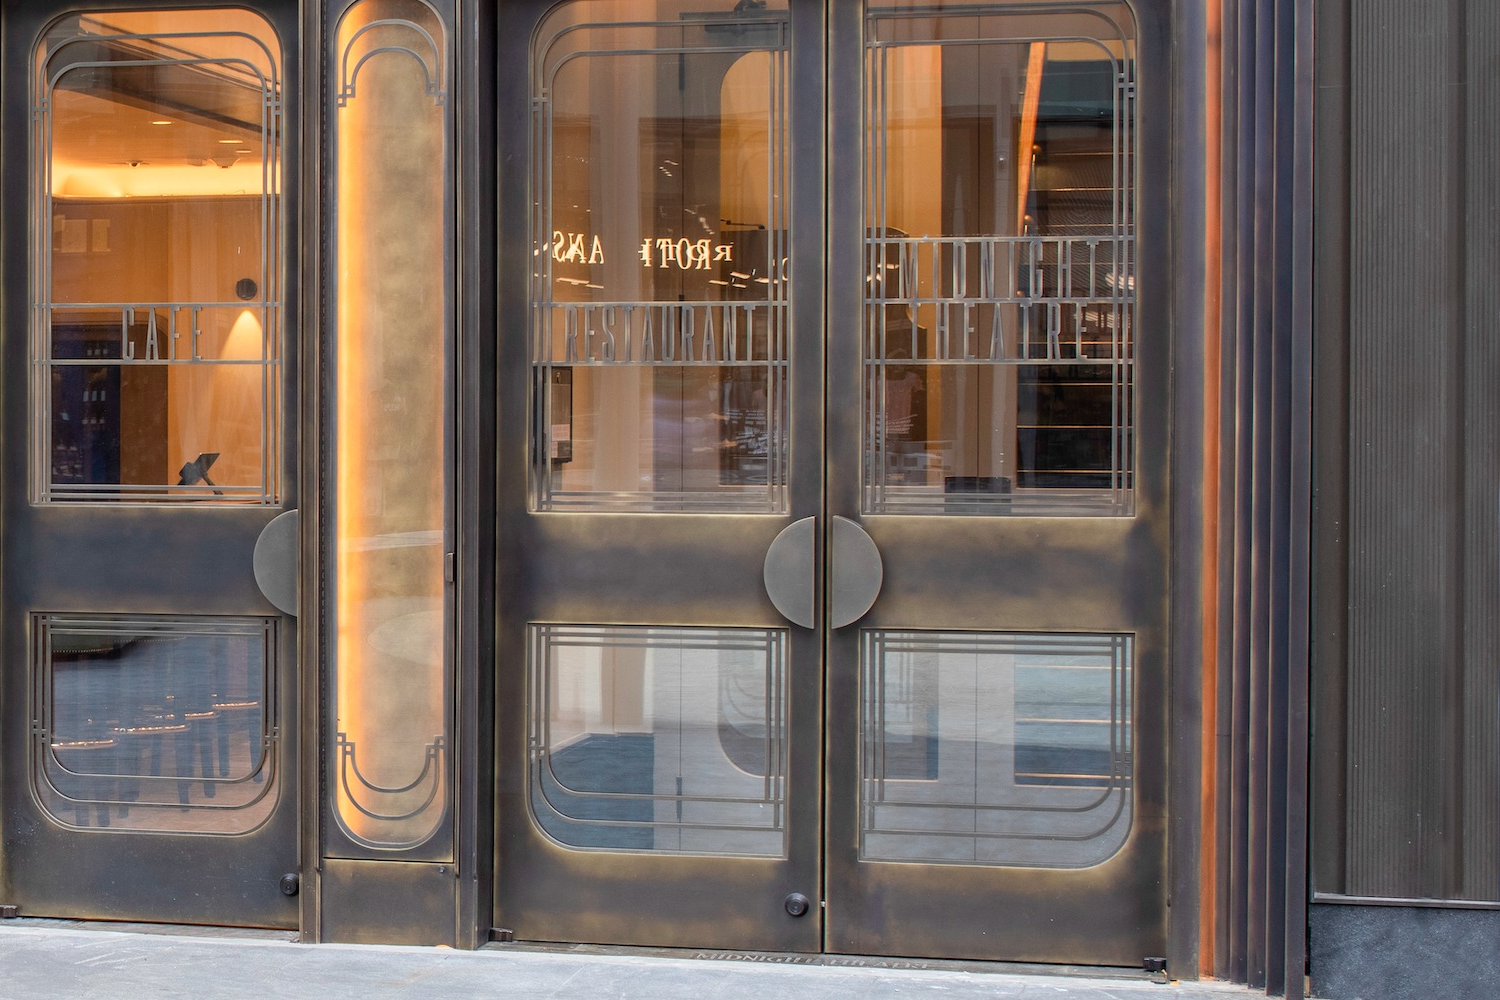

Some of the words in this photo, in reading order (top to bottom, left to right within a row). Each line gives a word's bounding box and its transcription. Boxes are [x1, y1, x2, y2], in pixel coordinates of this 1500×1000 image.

[900, 240, 1100, 299] MIDNIGHT
[122, 305, 202, 362] CAFE
[565, 305, 755, 362] RESTAURANT
[909, 302, 1087, 360] THEATRE
